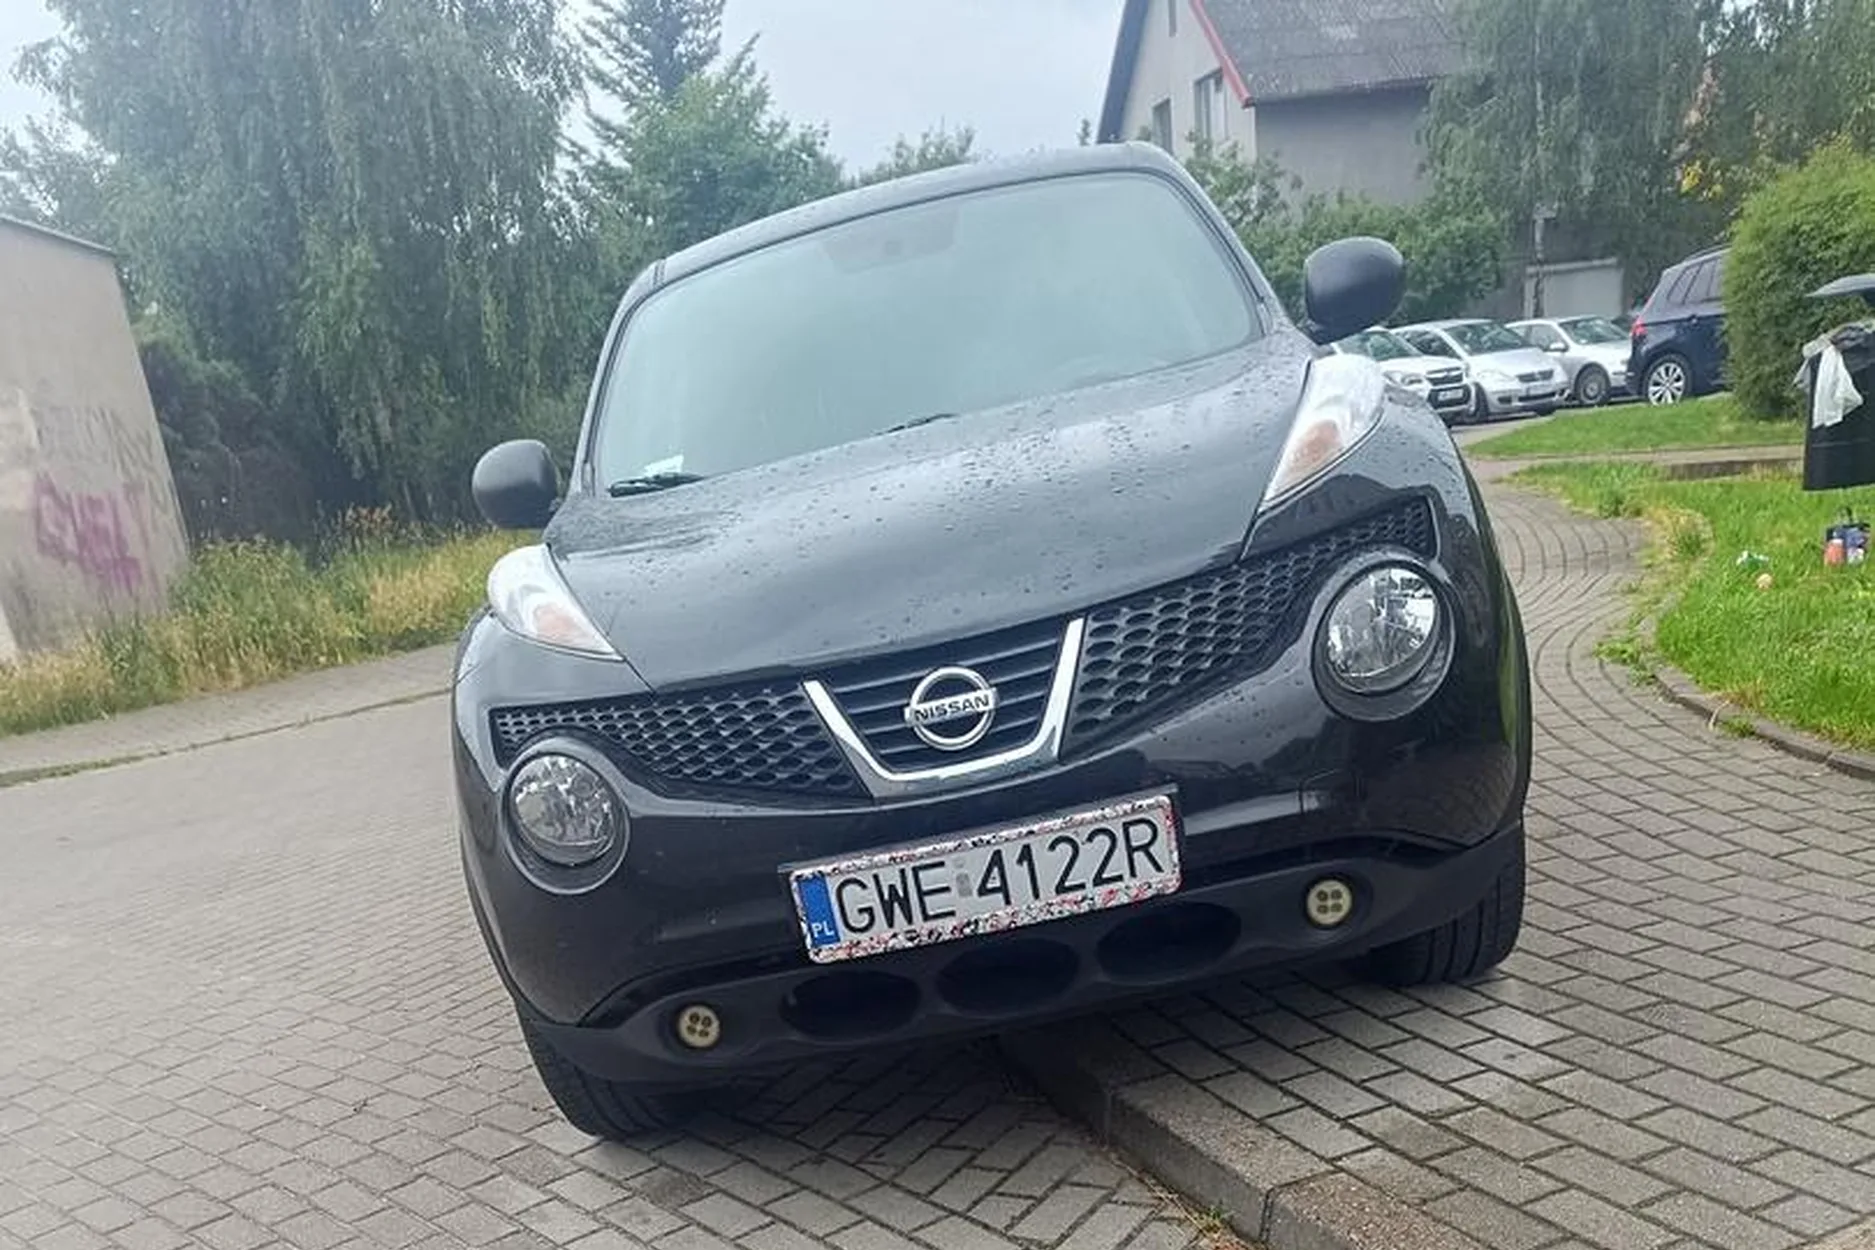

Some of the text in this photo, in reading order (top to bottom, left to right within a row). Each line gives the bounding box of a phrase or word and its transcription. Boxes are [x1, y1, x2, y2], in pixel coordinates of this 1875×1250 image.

[914, 694, 990, 722] NISSAN
[835, 818, 1165, 934] GWE 4122R
[811, 920, 835, 938] PL
